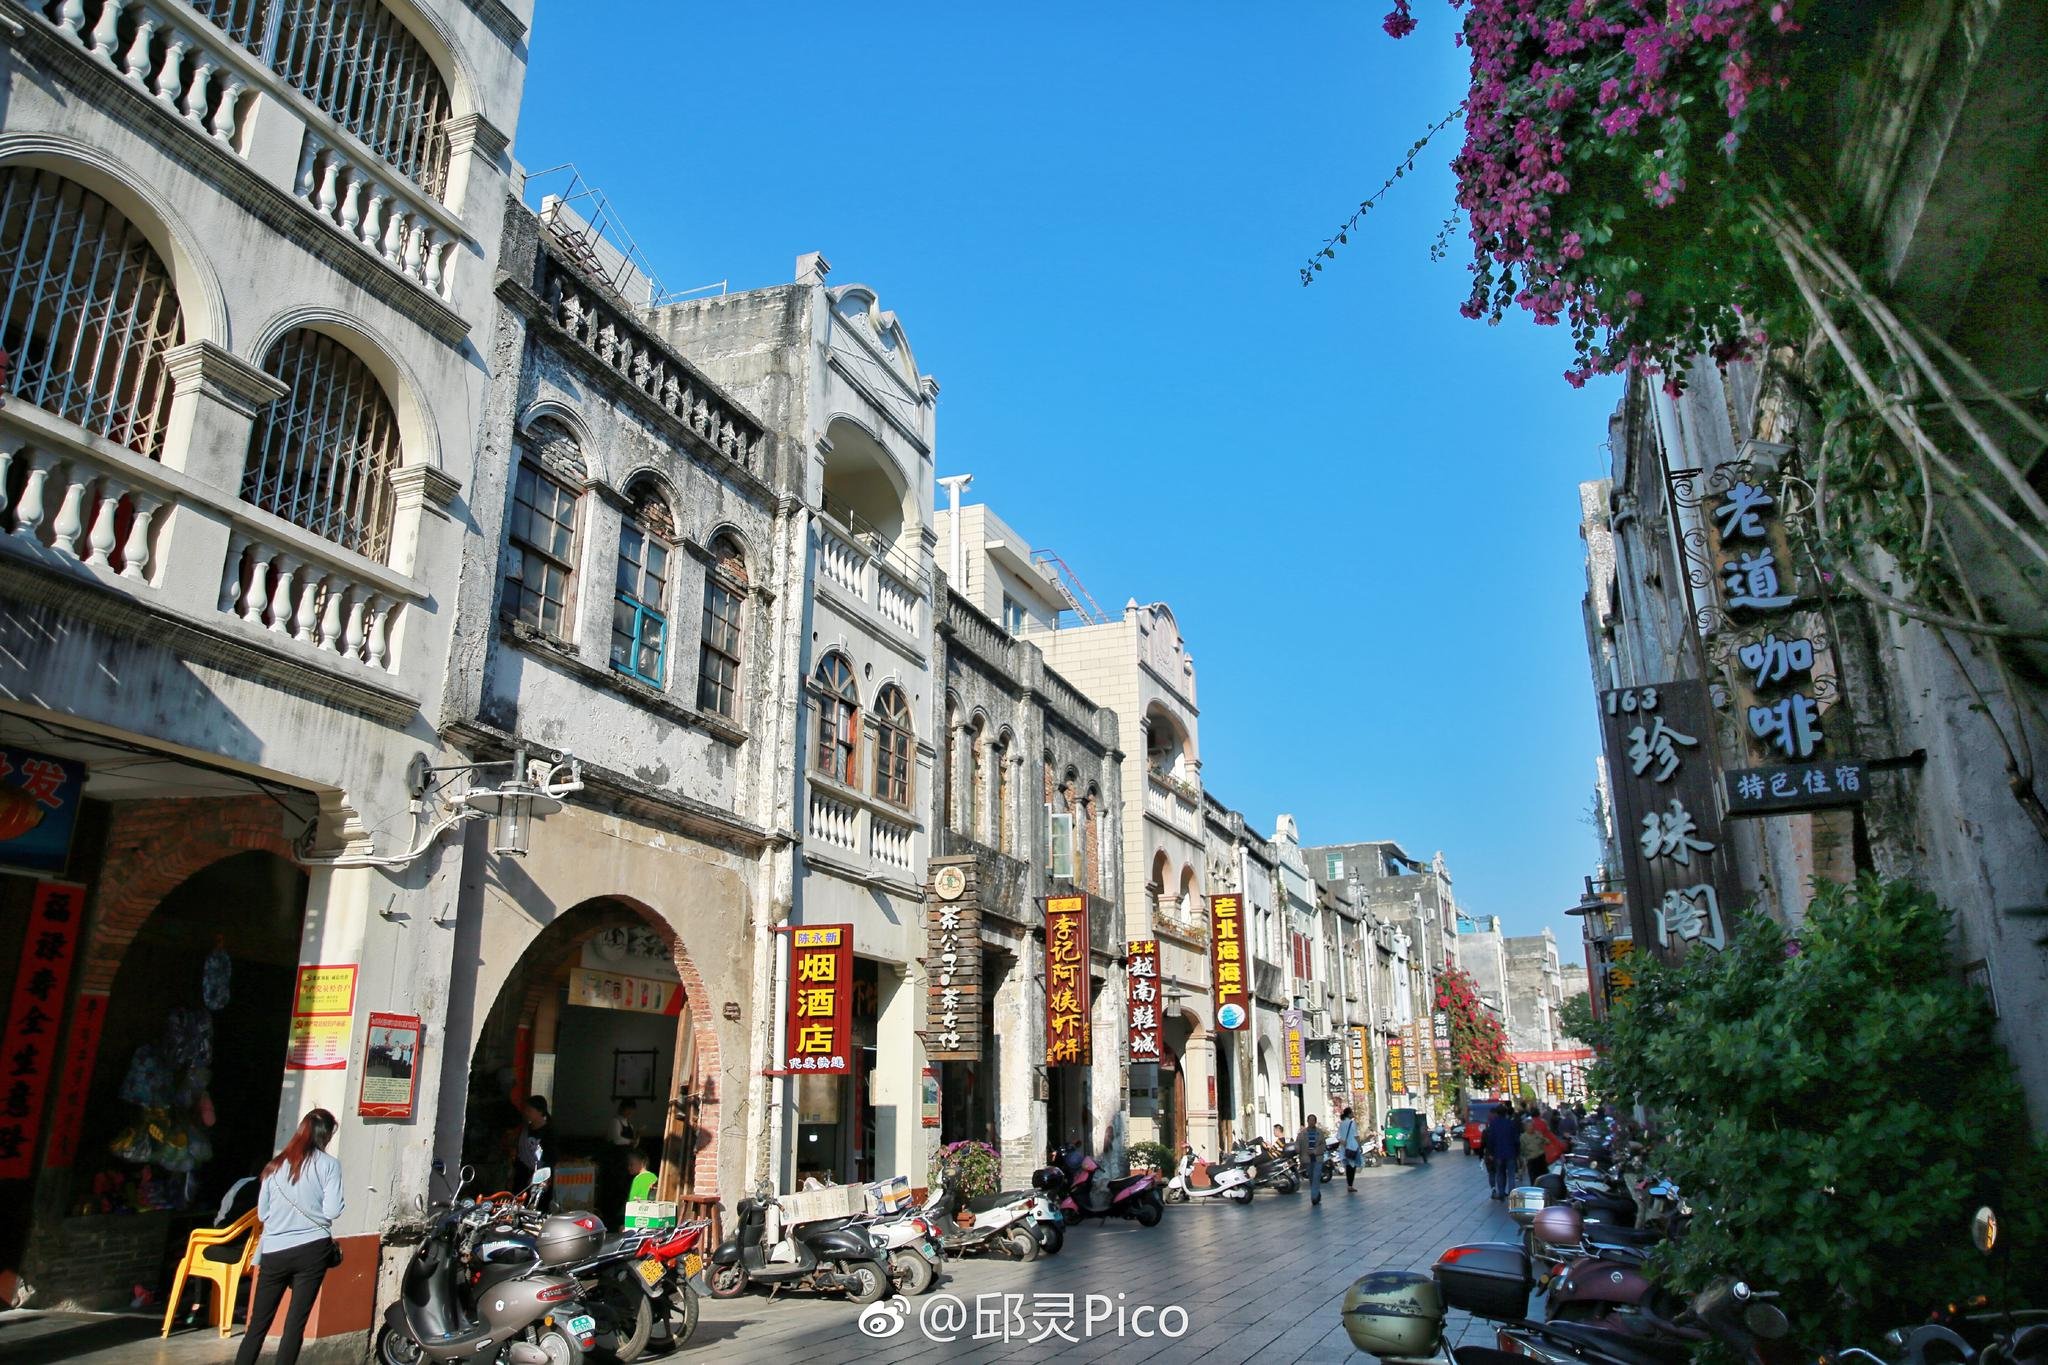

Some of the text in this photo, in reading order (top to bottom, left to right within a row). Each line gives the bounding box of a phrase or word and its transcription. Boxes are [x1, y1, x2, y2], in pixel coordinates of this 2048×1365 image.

[1715, 482, 1824, 758] 老道咖啡
[1606, 688, 1658, 715] 163
[1737, 765, 1861, 801] 特色住宿
[1627, 716, 1726, 952] 珍珠阁
[798, 931, 837, 945] 陈永新
[1215, 897, 1241, 1004] 老北海海产
[796, 953, 836, 1053] 烟酒店
[1050, 914, 1082, 1063] 李记阿姨虾饼
[1129, 956, 1159, 1056] 越南鞋城
[1434, 1013, 1448, 1037] 老街
